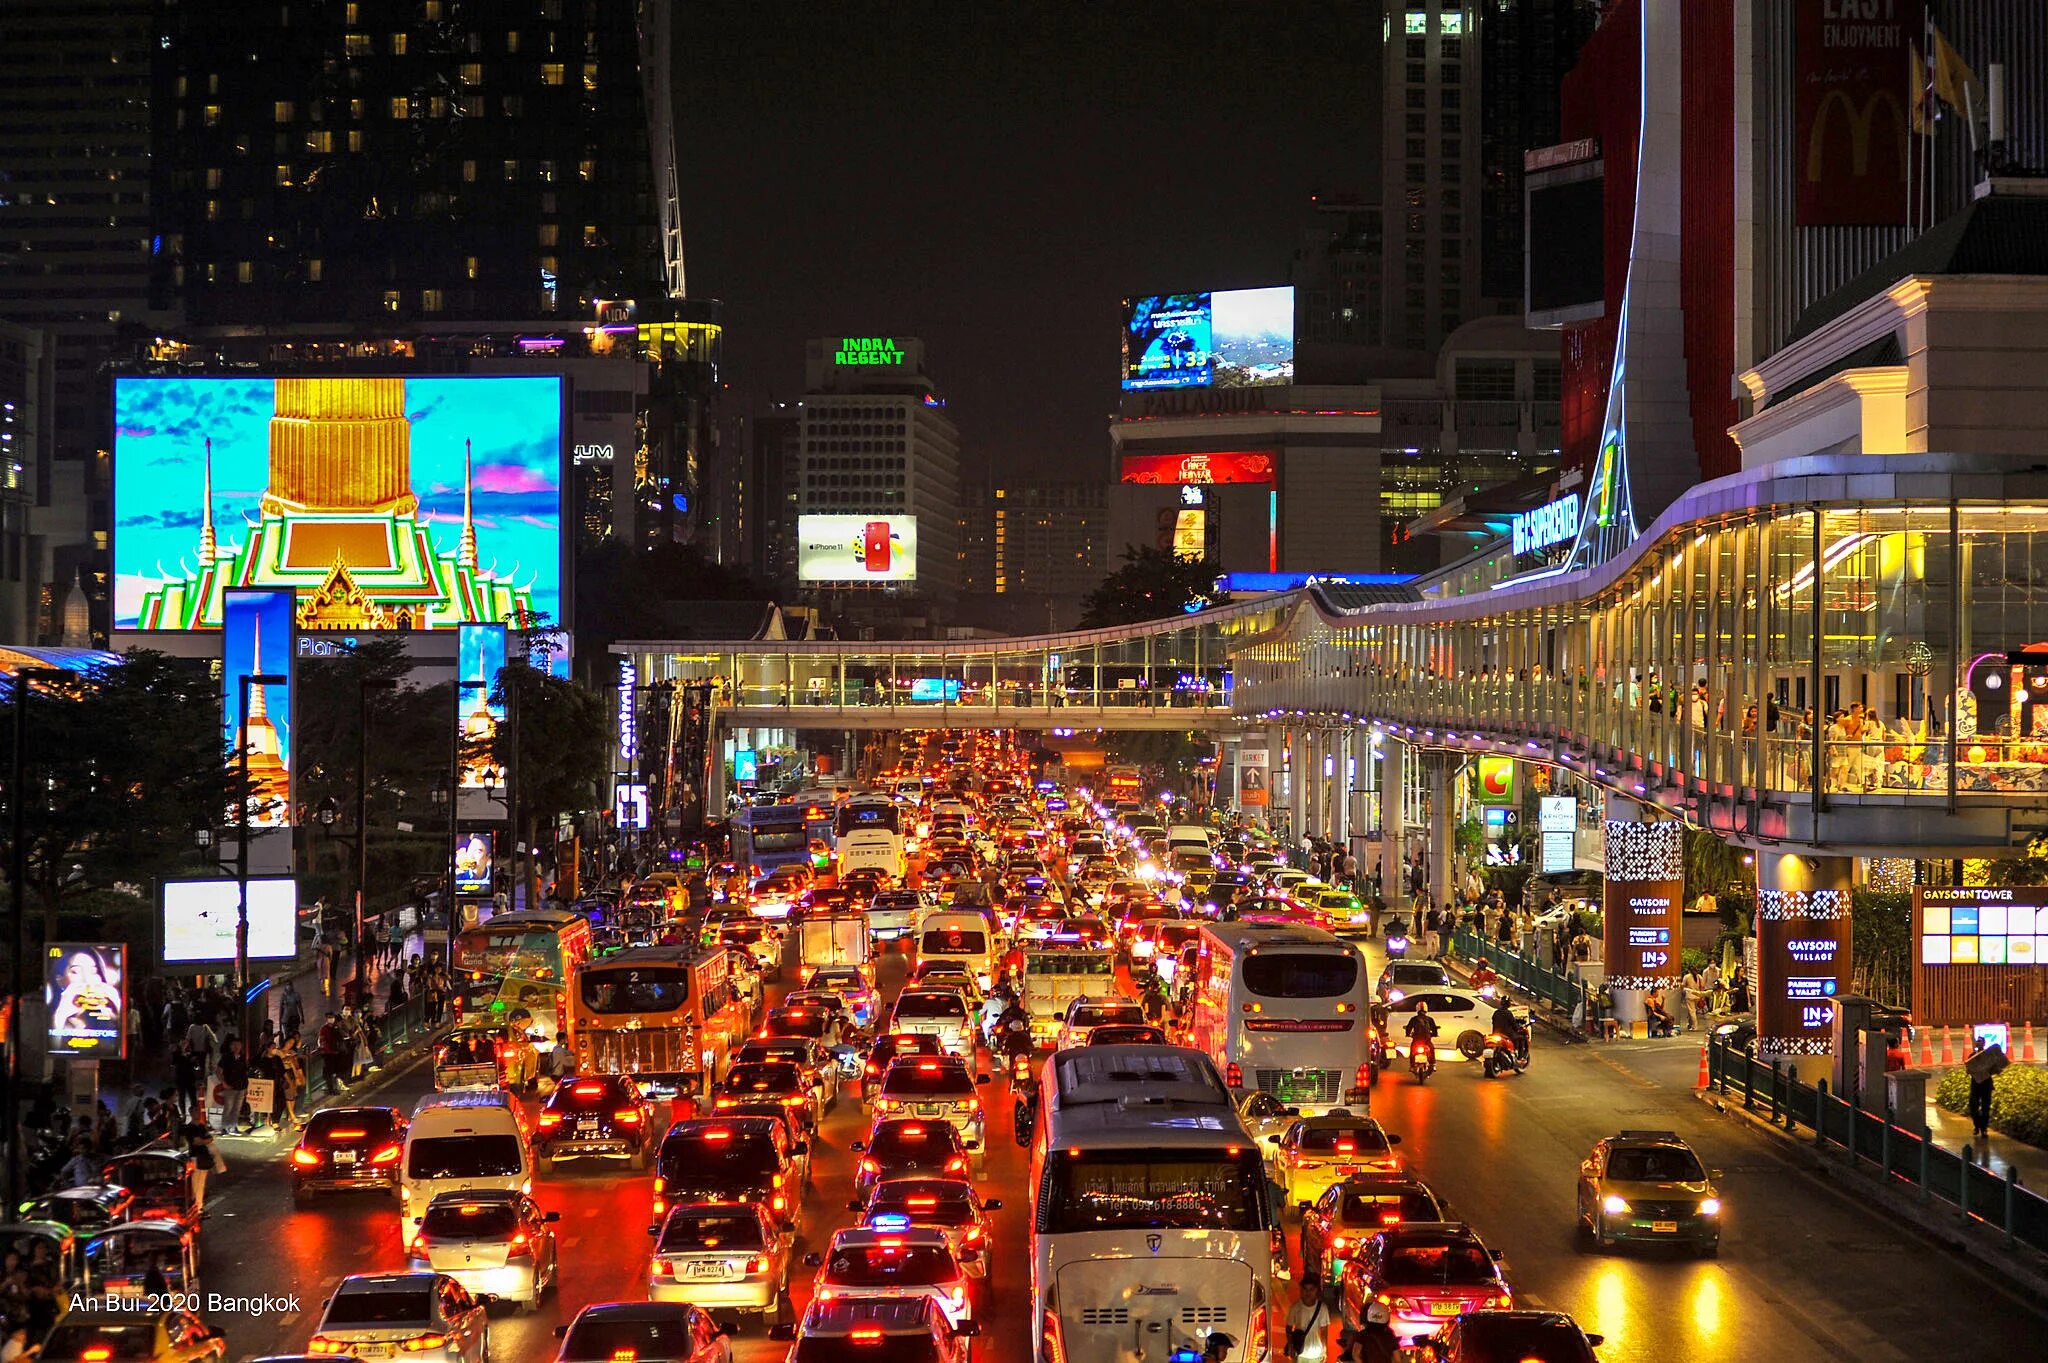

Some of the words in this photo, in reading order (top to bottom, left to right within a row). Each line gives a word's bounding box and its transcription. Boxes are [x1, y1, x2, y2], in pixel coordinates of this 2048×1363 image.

[1823, 24, 1902, 48] ENJOYMENT
[842, 338, 895, 351] INDRA
[835, 351, 904, 365] REGENT
[1531, 494, 1578, 550] SUPERCENTER
[814, 543, 835, 551] iPhone
[1923, 890, 1975, 900] GAYSORN
[1975, 889, 2013, 900] TOWER
[1629, 898, 1670, 907] GAYSORN
[1788, 941, 1837, 951] GAYSORN
[1642, 952, 1657, 963] IN
[1793, 953, 1832, 961] VILLAGE
[630, 971, 639, 982] 2
[1804, 1007, 1821, 1020] IN
